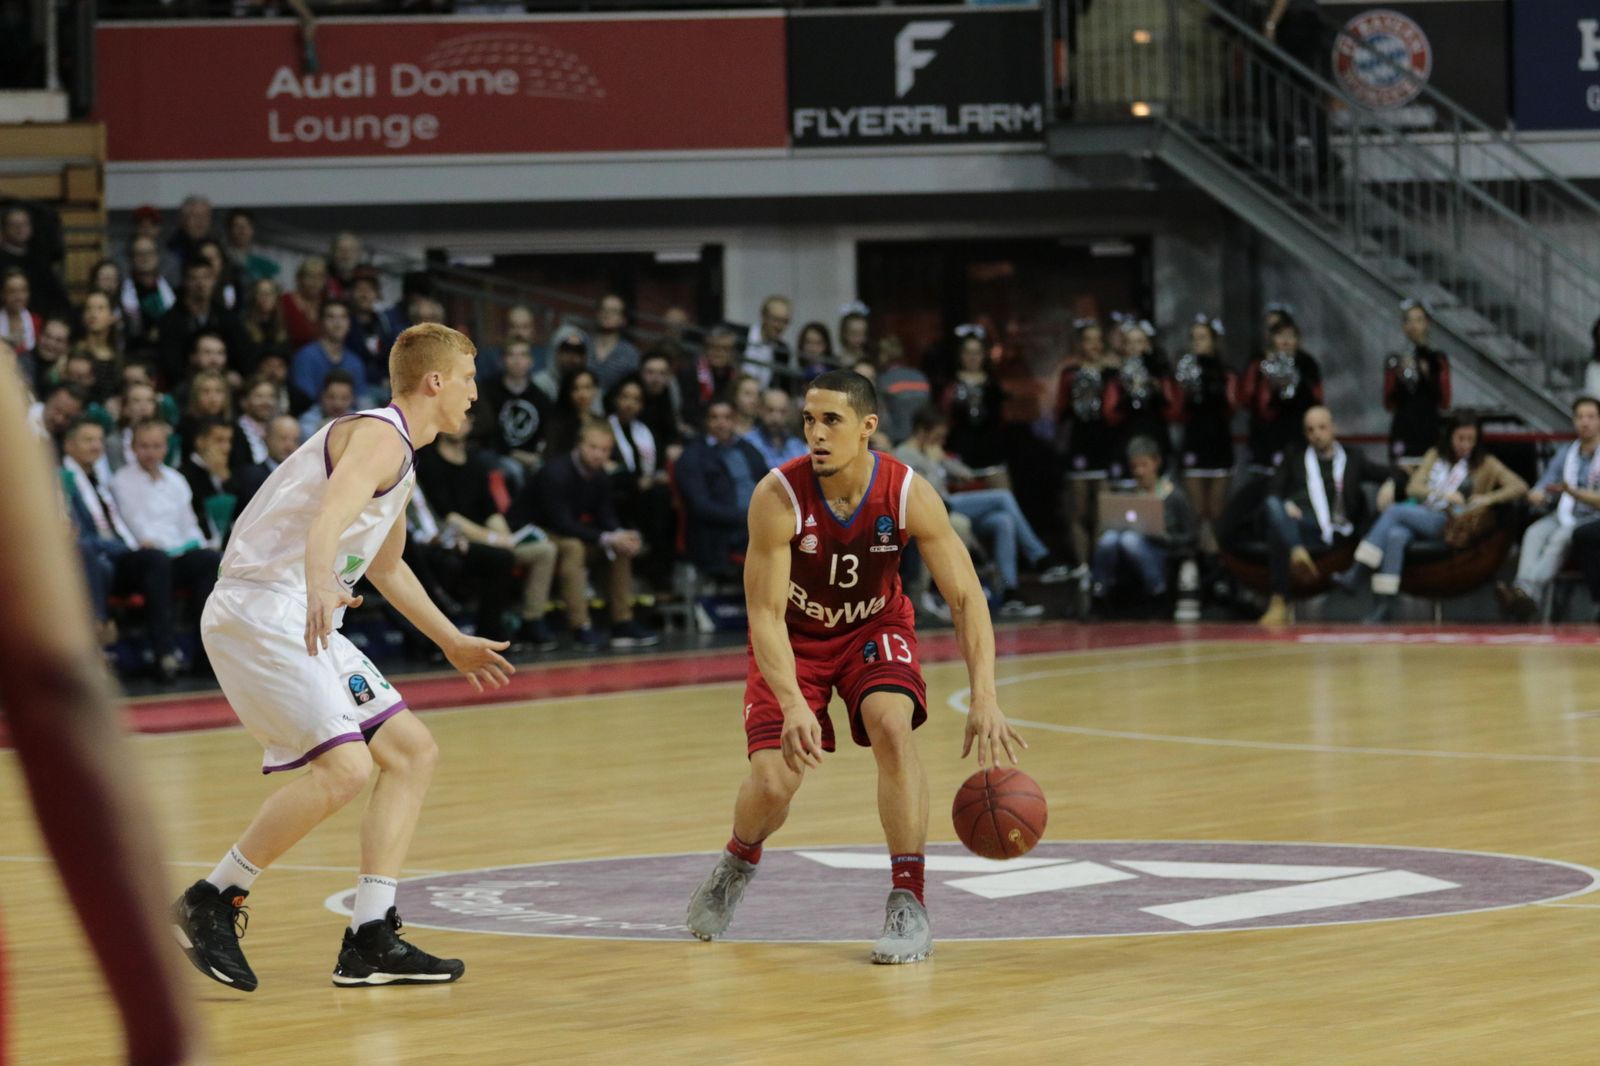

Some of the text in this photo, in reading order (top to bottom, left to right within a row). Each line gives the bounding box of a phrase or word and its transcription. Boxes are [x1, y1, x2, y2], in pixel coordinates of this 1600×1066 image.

[266, 63, 520, 99] Audi Dome
[267, 110, 440, 148] Lounge
[793, 103, 1043, 138] FLYERALARM
[828, 553, 860, 589] 13
[787, 579, 887, 629] BayWa
[881, 632, 913, 664] 13
